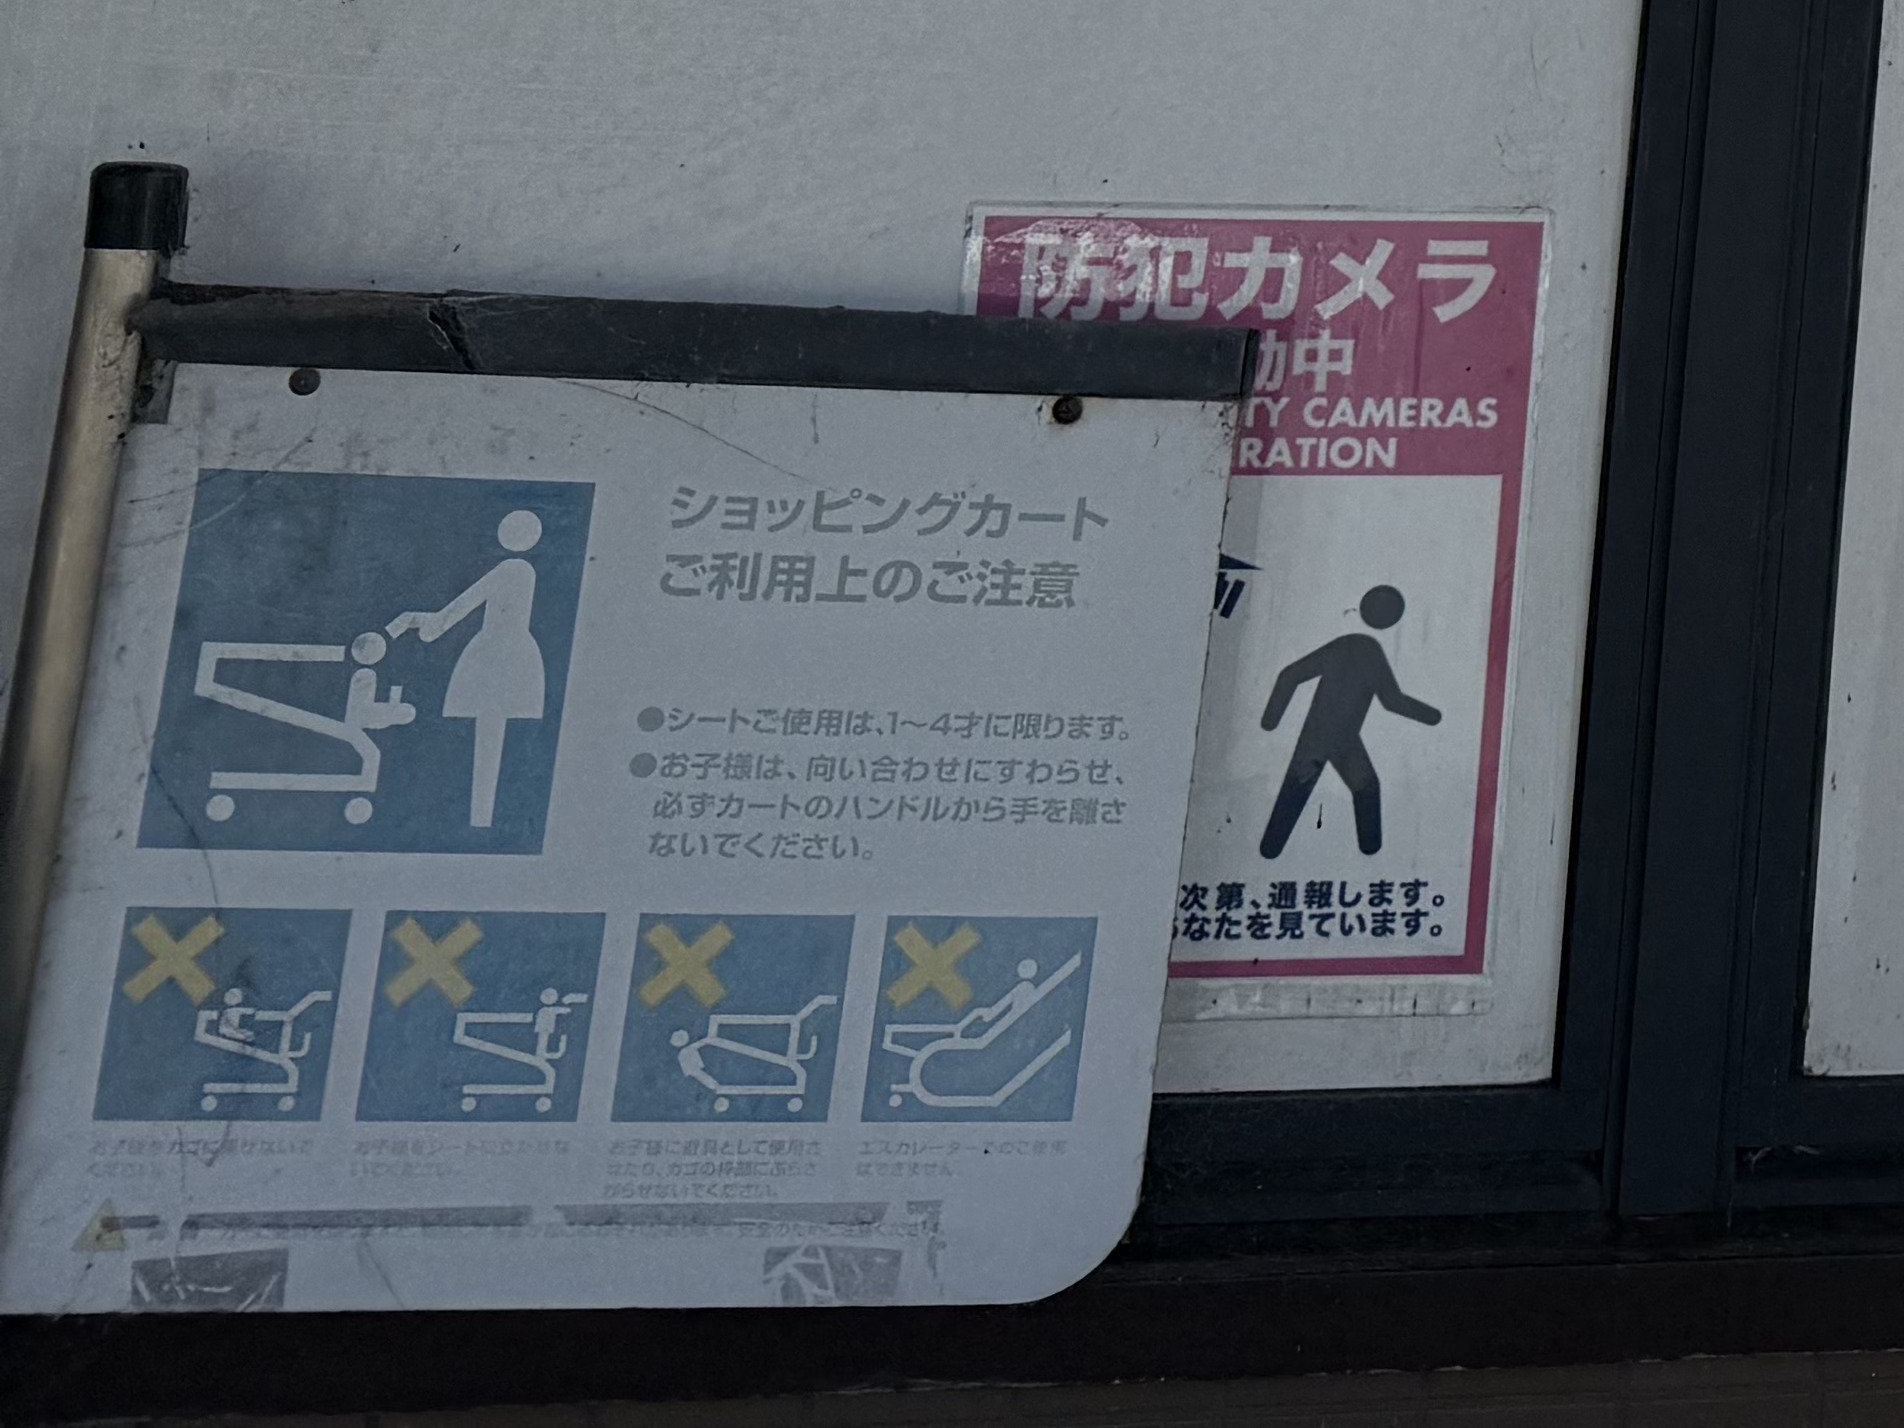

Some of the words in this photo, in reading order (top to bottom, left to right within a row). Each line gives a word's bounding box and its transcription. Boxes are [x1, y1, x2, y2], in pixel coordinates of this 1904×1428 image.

[1018, 234, 1496, 323] 防犯カメラ
[1303, 396, 1498, 430] CAMERAS
[670, 486, 1108, 542] ショッピングカート
[660, 551, 1079, 609] ご利用上のご注意
[653, 792, 1127, 826] 必ずカートのハンドルから手を離さ
[648, 831, 873, 861] ないでください。
